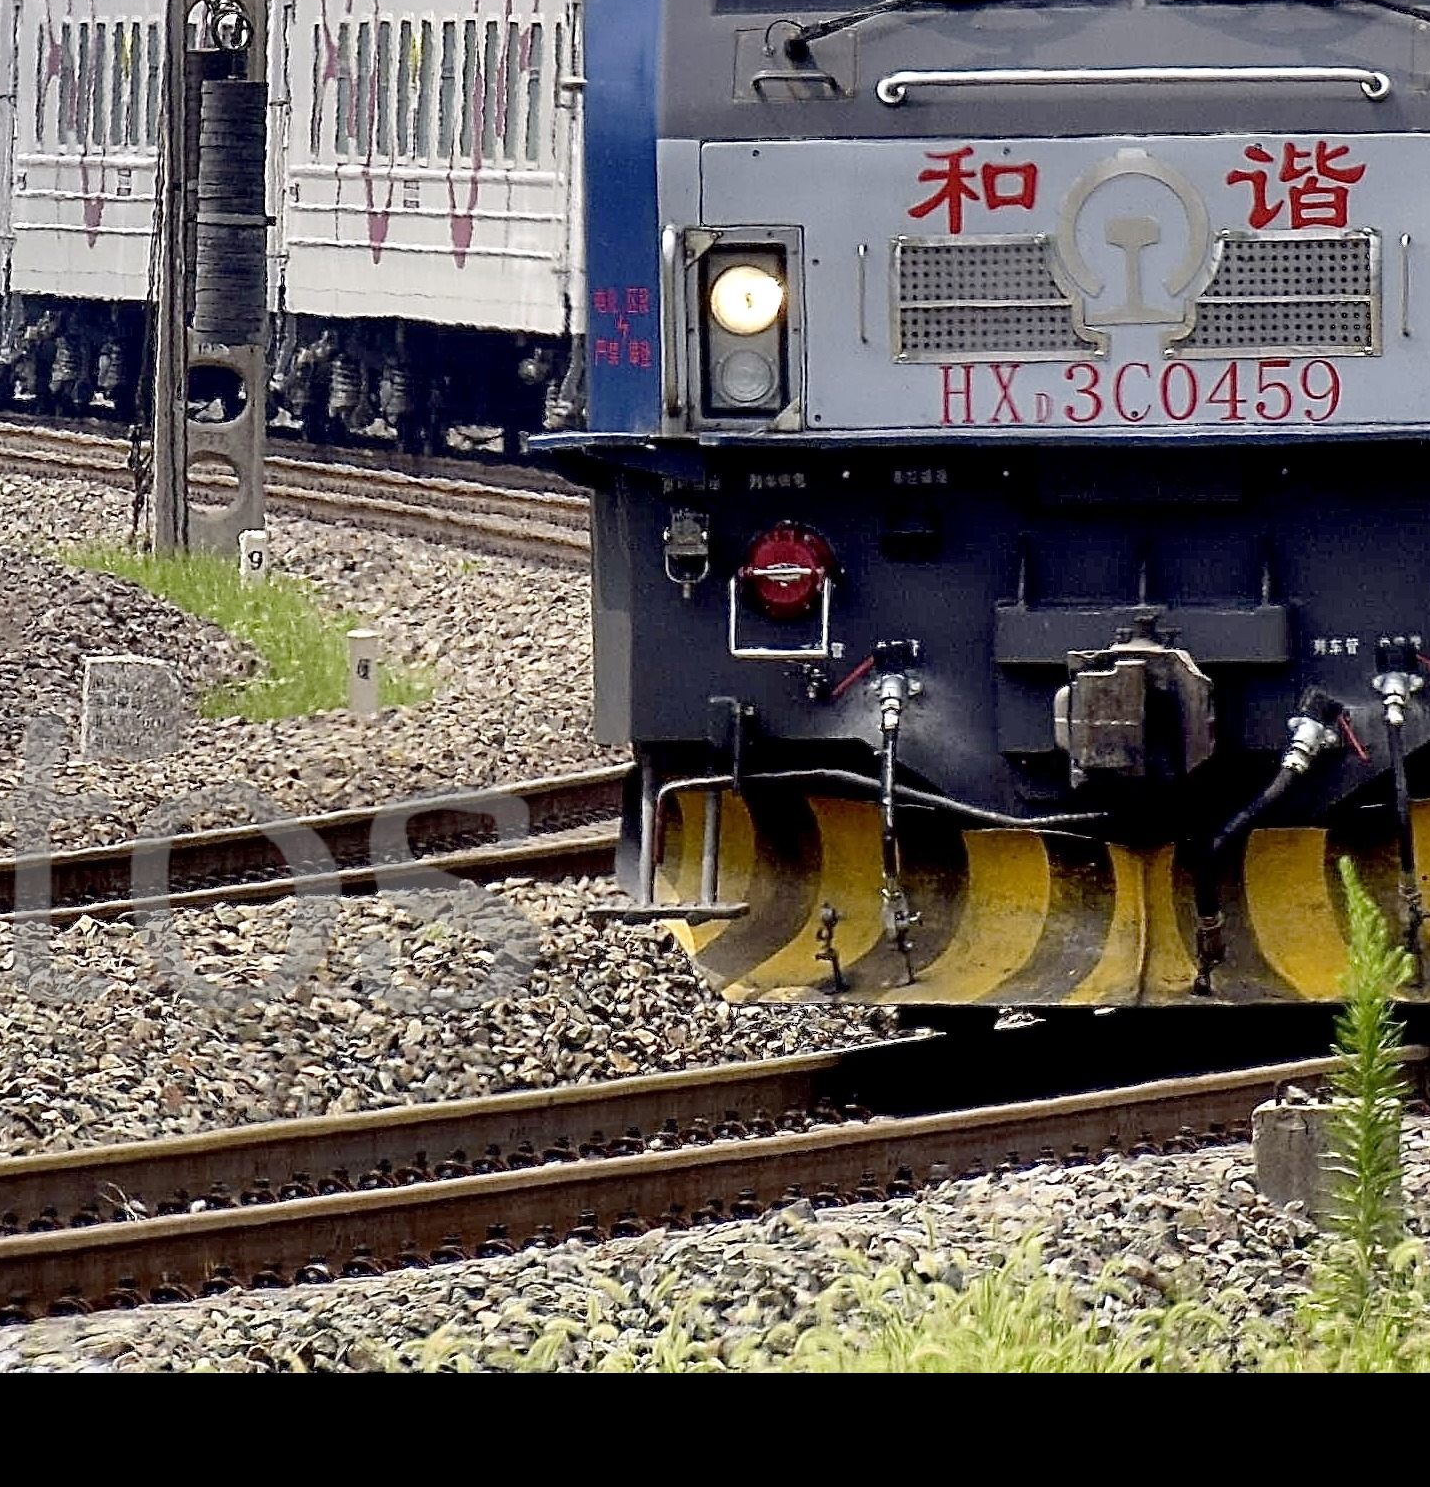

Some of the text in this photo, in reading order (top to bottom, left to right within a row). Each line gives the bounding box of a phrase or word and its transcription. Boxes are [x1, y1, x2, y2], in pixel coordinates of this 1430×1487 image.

[908, 140, 1367, 235] 和 谐
[248, 550, 263, 570] 9
